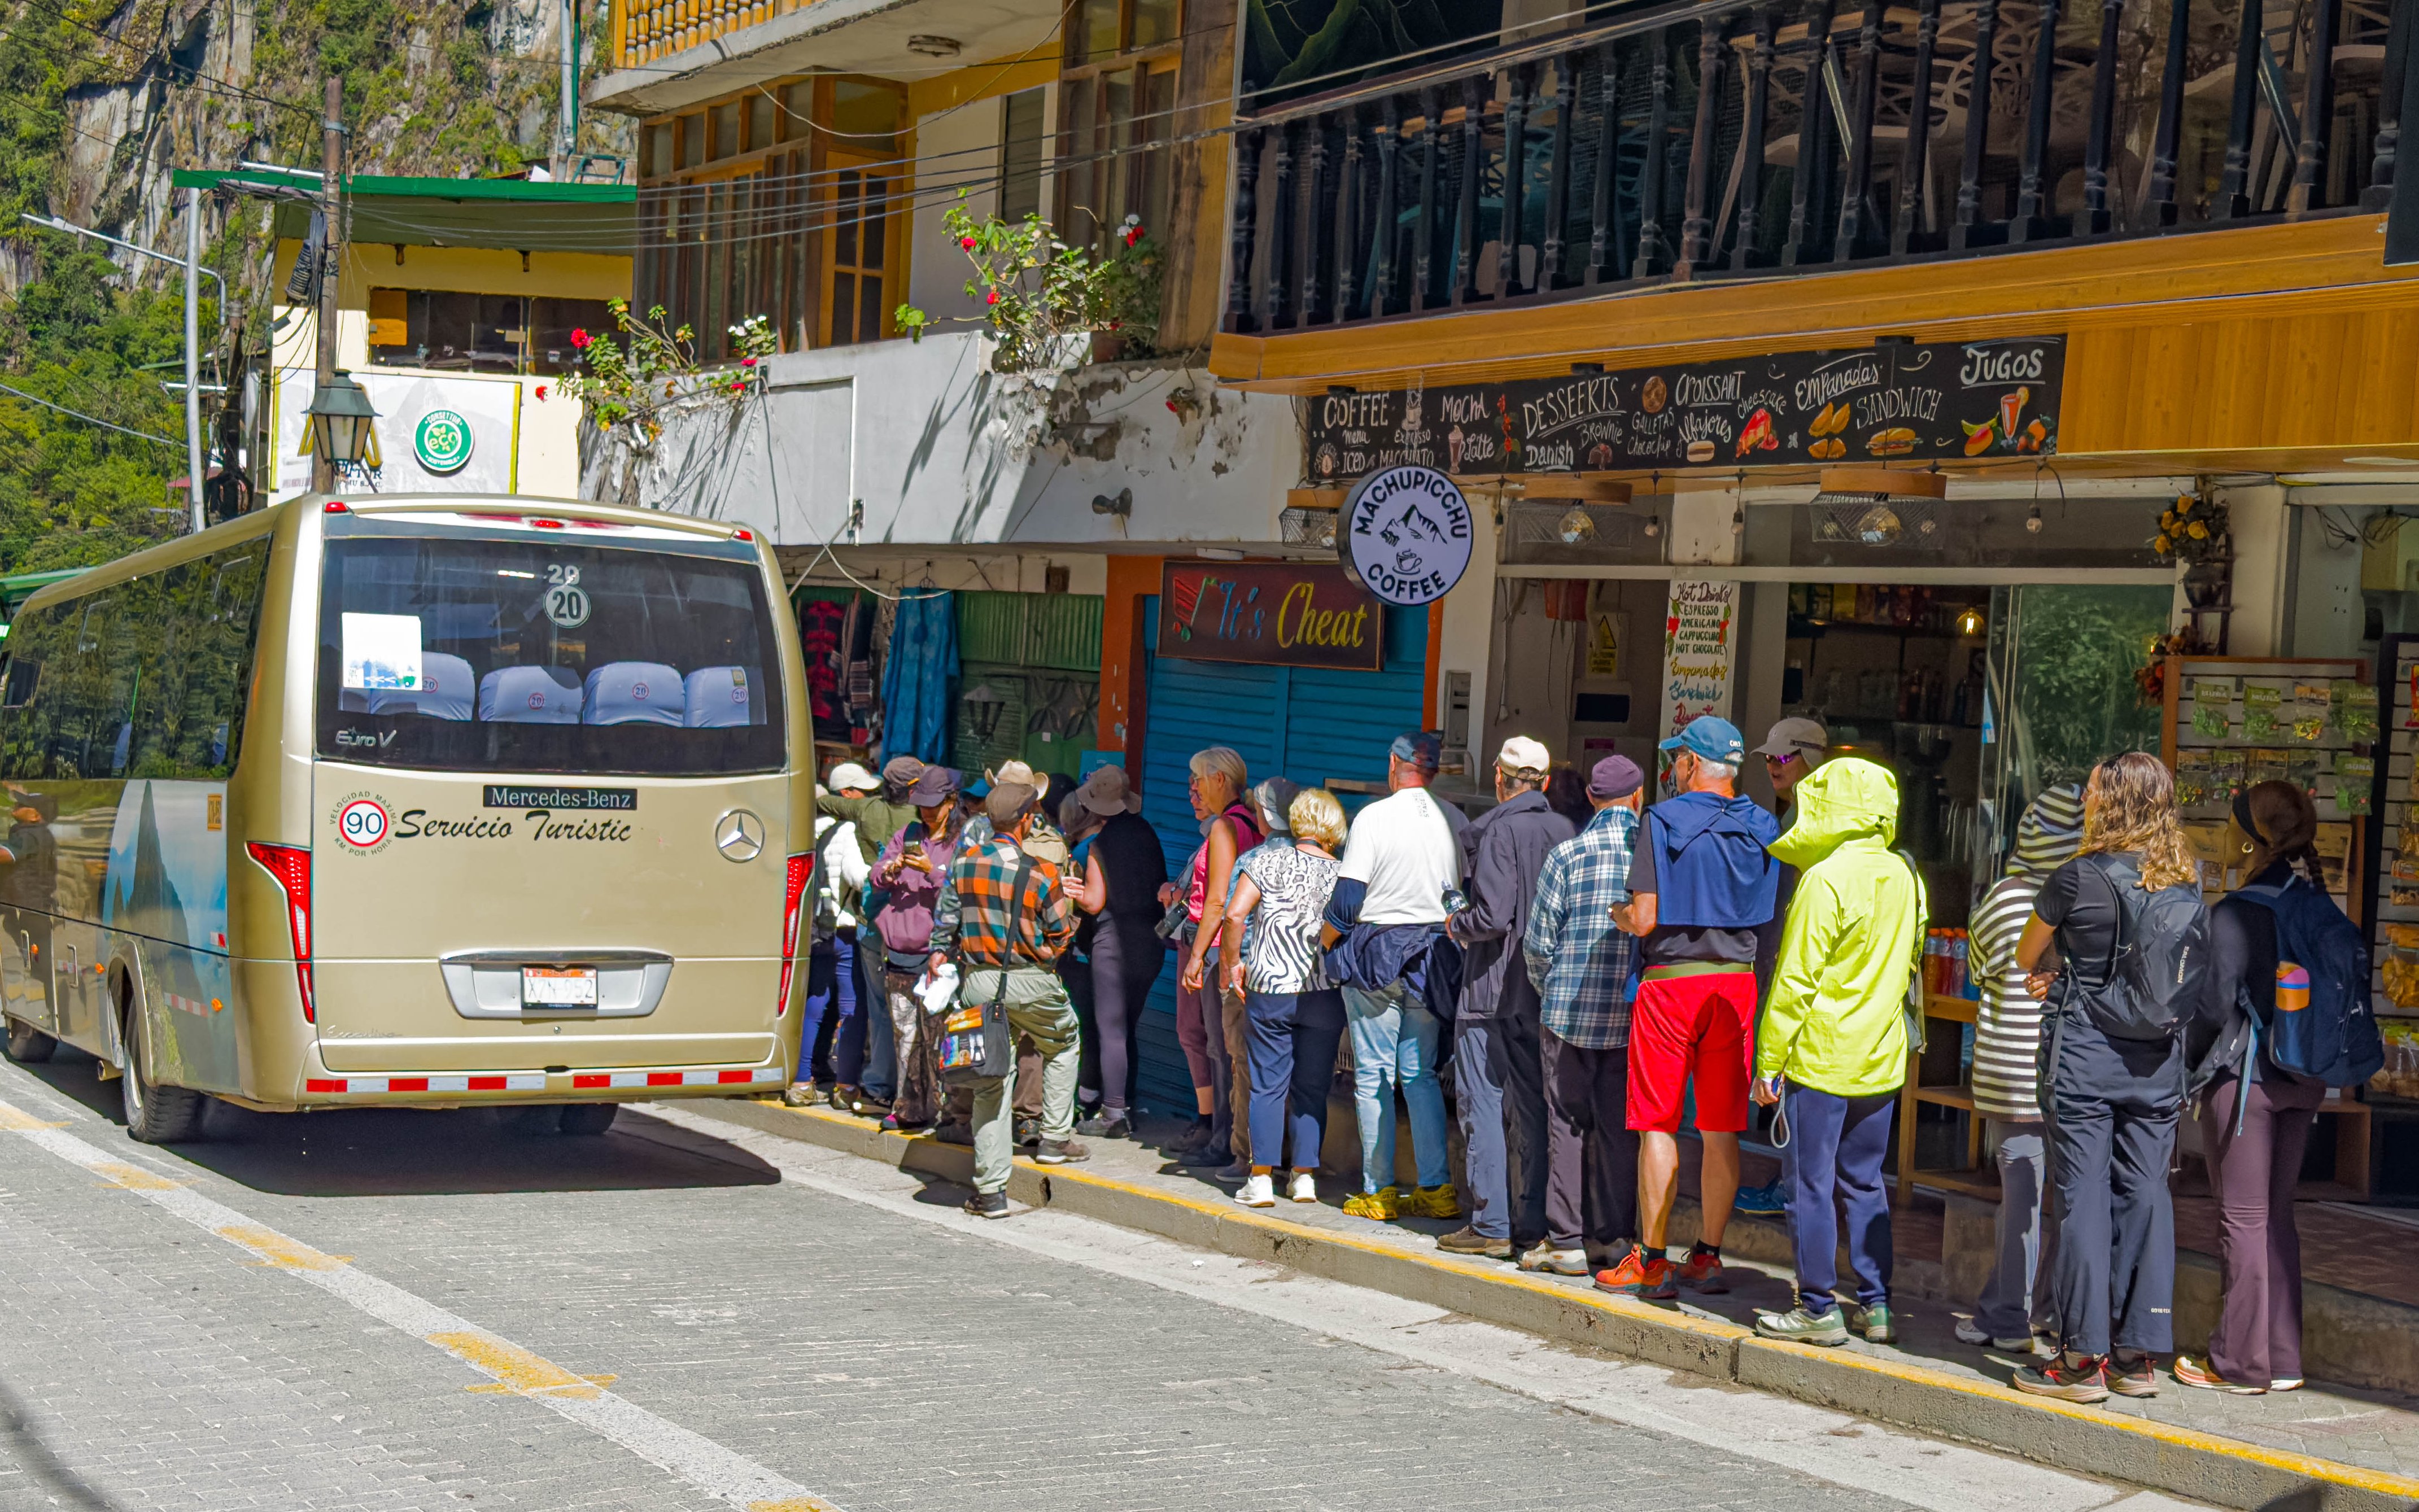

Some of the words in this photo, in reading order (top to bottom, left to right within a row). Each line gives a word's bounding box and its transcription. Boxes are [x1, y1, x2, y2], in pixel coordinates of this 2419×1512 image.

[1960, 348, 2044, 385] JUGOS
[1675, 371, 1745, 405] CROISSANT
[1324, 392, 1390, 429] COFFEE
[1632, 407, 1674, 435] GALLETAS
[1856, 386, 1944, 430] SANDWICH
[1465, 434, 1495, 462] Latte
[1525, 439, 1574, 467] Danish
[1355, 470, 1467, 539] MACHUPICCHU
[1368, 563, 1446, 600] COFFEE
[553, 591, 582, 620] 20
[1218, 580, 1265, 641] It's
[1276, 582, 1368, 649] Cheat
[1684, 605, 1719, 616] ESPRESSO
[1680, 618, 1721, 628] AMERICANO
[1676, 644, 1688, 654] HOT
[1692, 644, 1724, 655] CHOCOLATE
[532, 697, 542, 706] 20
[636, 687, 646, 696] 20
[735, 691, 745, 700] 20
[379, 729, 397, 748] V
[330, 791, 370, 825] VELOCIDAD
[375, 794, 397, 825] MAXIMA
[491, 788, 631, 808] Mercedes-Benz
[347, 812, 382, 834] 90
[395, 809, 513, 838] Servicio
[525, 810, 632, 841] Turistic
[334, 837, 346, 849] KM
[348, 848, 366, 857] POR
[371, 839, 392, 855] HORA
